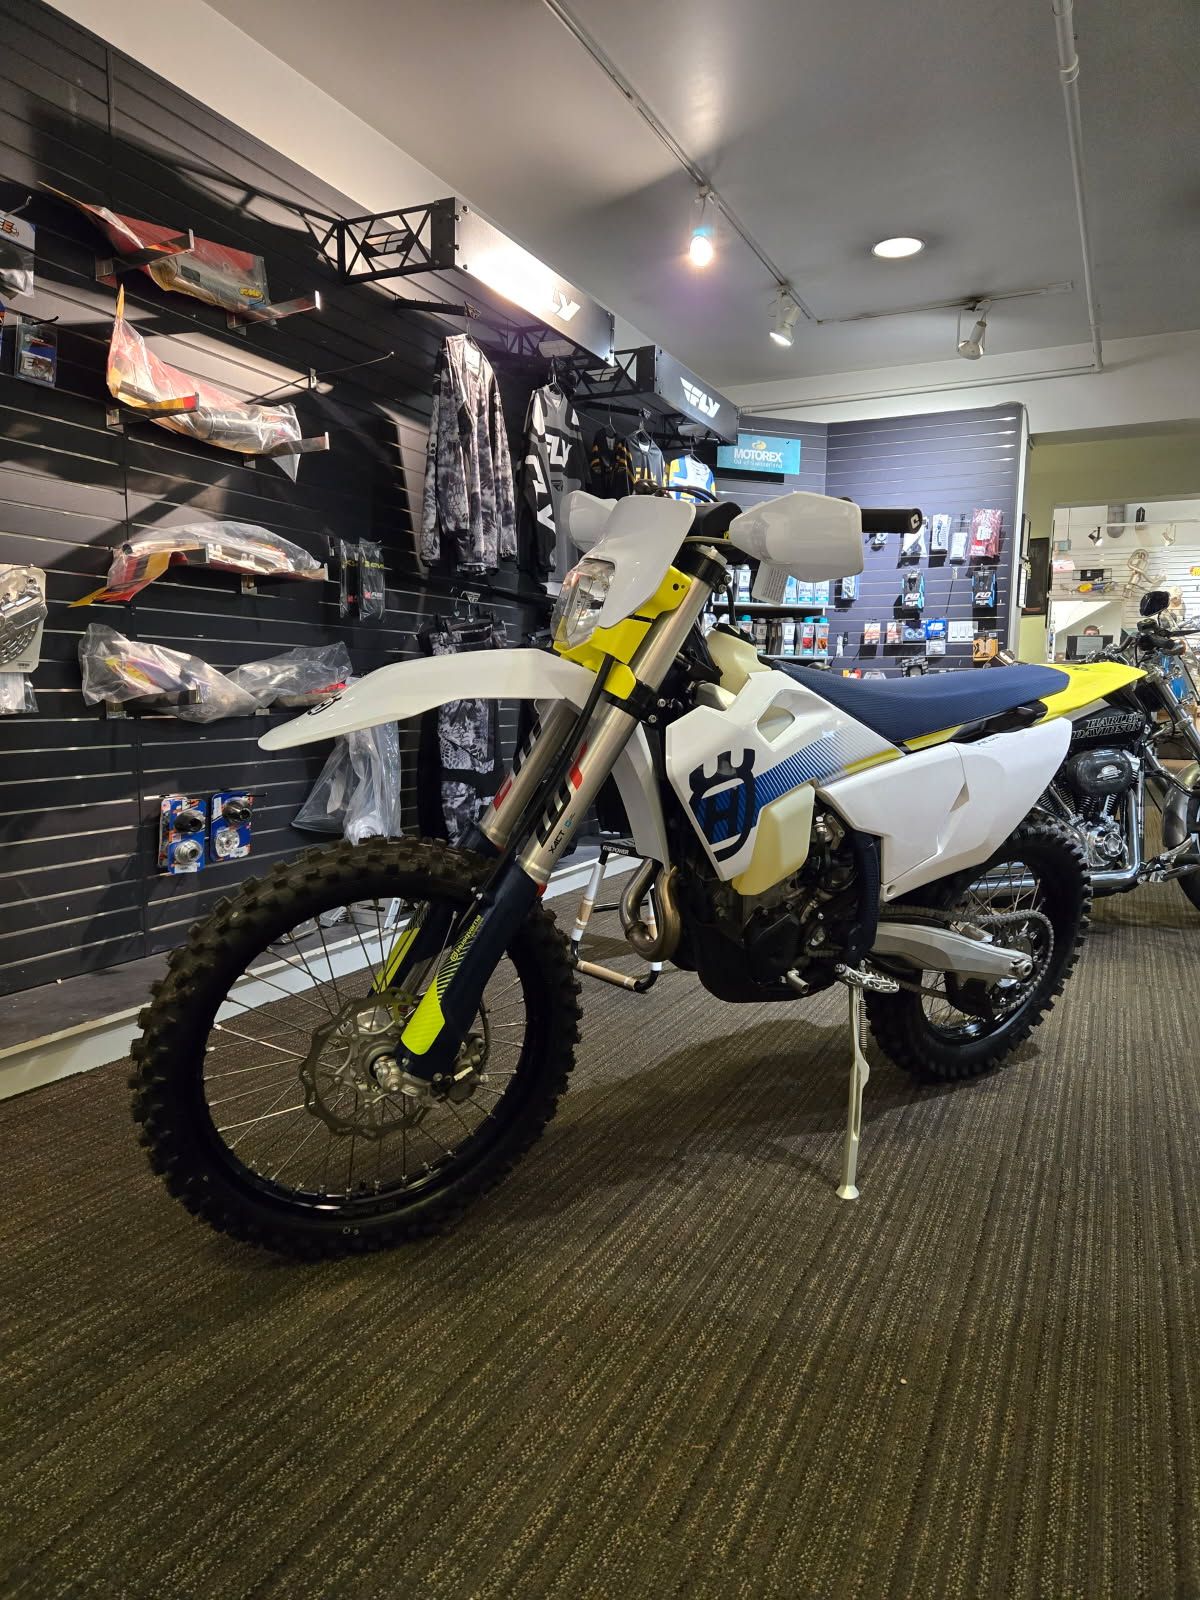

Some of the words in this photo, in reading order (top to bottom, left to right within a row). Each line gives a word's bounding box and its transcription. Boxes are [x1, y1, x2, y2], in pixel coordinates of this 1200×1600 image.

[681, 377, 720, 418] FLY
[733, 447, 783, 463] MOTOREX
[548, 829, 565, 854] XACT
[455, 914, 482, 953] Husqvarna
